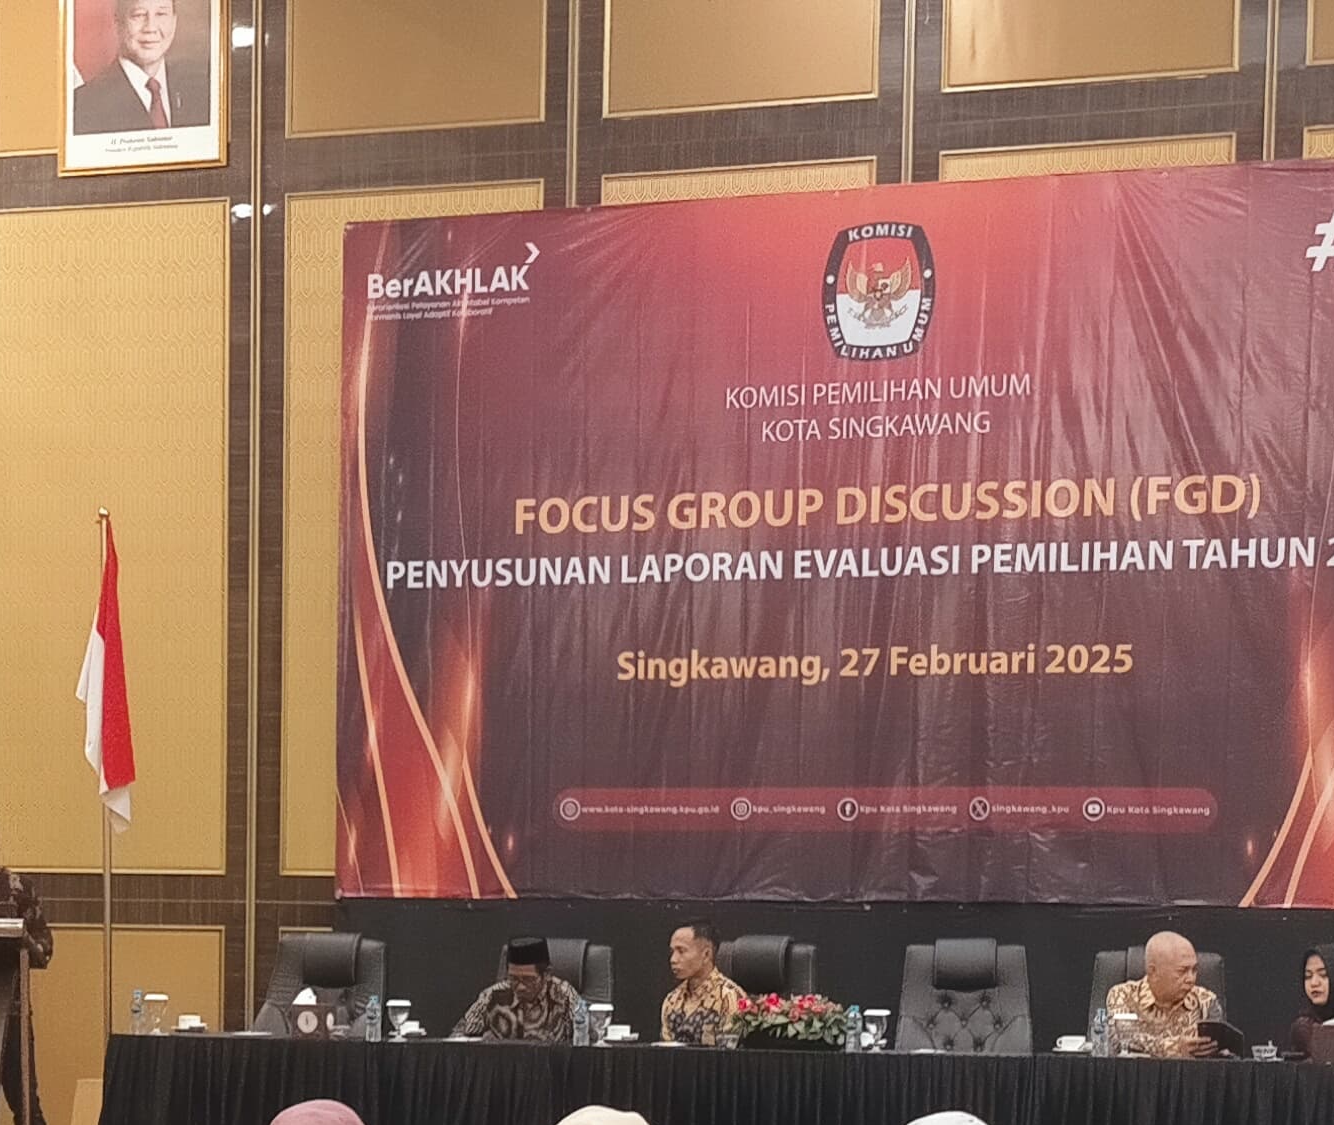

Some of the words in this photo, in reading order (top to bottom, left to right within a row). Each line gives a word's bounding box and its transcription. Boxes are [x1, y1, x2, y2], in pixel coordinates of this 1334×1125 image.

[848, 223, 913, 241] KOMISI
[367, 265, 530, 299] BerAKHLAK
[825, 303, 897, 359] PEMILIHAN
[902, 297, 932, 353] UMUM
[726, 382, 806, 409] KOMISI
[813, 376, 941, 406] PEMILIHAN
[949, 372, 1032, 399] UMUM
[761, 417, 821, 443] KOTA
[828, 411, 991, 440] SINGKAWANG
[515, 496, 657, 536] FOCUS
[667, 490, 823, 532] GROUP
[836, 477, 1116, 526] DISCUSSION
[1130, 471, 1262, 521] (FGD)
[386, 555, 612, 590] PENYUSUNAN
[620, 549, 784, 585] LAPORAN
[793, 544, 961, 580] EVALUASI
[970, 539, 1175, 575] PEMILIHAN
[1183, 536, 1317, 571] TAHUN
[616, 648, 831, 687] Singkawang,
[839, 648, 880, 678] 27
[889, 643, 1035, 676] Februari
[1045, 643, 1134, 675] 2025
